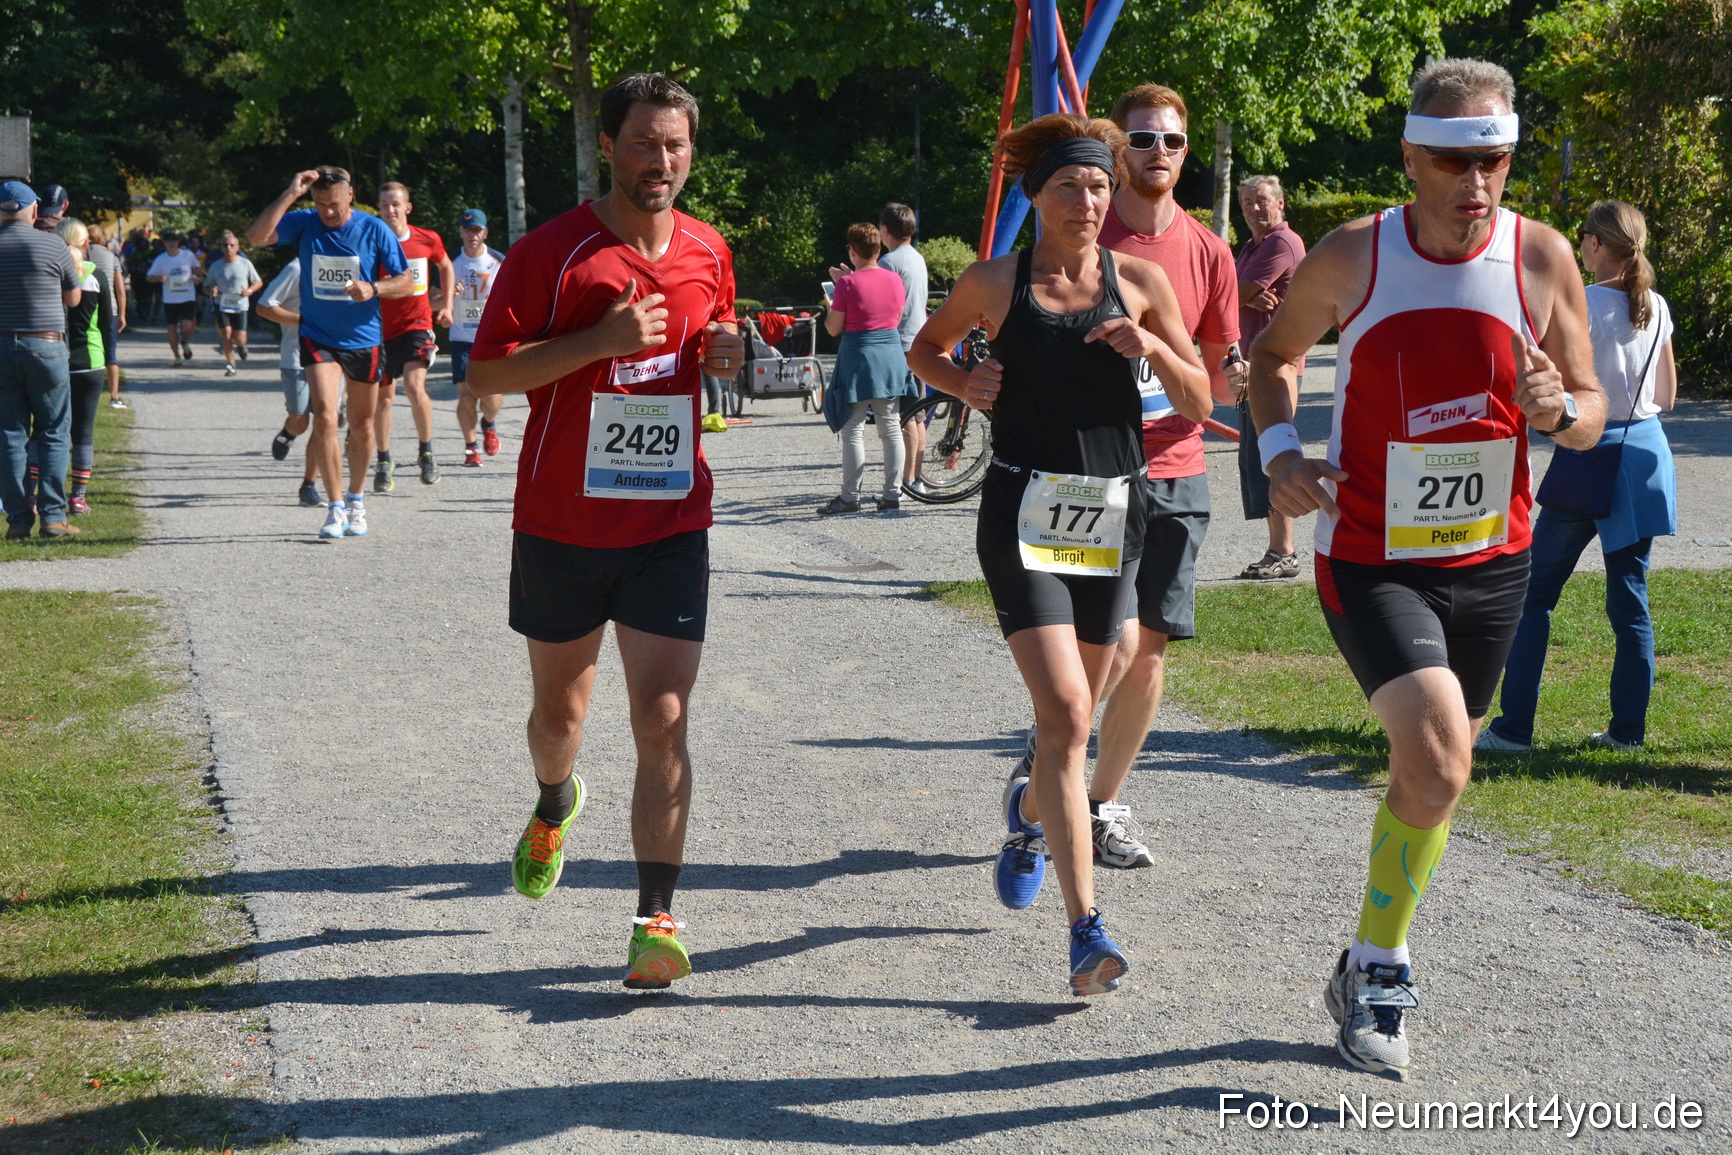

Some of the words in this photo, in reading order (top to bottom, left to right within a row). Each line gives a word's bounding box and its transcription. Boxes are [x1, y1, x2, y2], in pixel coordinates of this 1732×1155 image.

[318, 268, 352, 282] 2055
[632, 363, 659, 378] DEHN
[624, 404, 669, 416] BOCK
[1430, 406, 1466, 424] DEHN
[605, 423, 680, 456] 2429
[1425, 452, 1479, 466] BOCK
[614, 472, 667, 487] Andreas
[1056, 484, 1103, 498] BOCK
[1418, 473, 1483, 510] 270
[1048, 502, 1104, 534] 177
[1442, 511, 1477, 521] Neumarkt
[1040, 534, 1060, 542] PARTL
[1062, 536, 1092, 544] Neumarkt
[1432, 529, 1469, 543] Peter
[1053, 549, 1085, 566] Birgit
